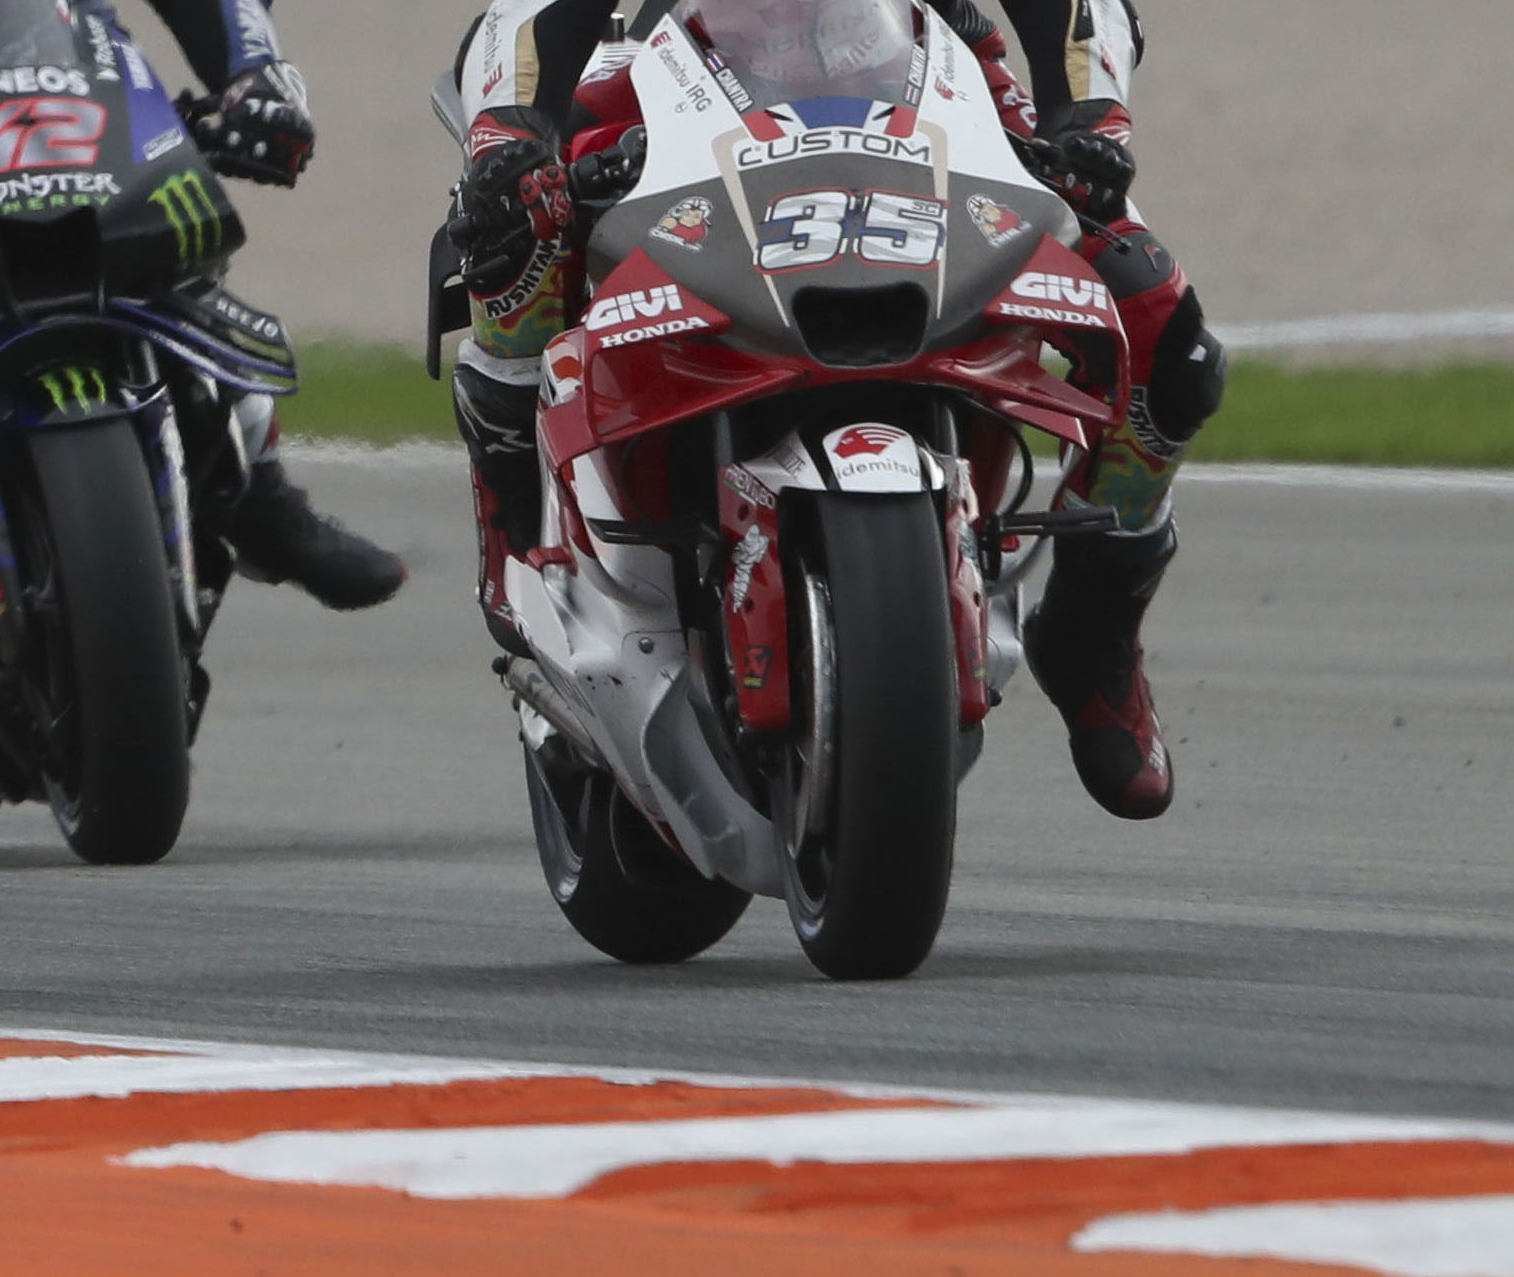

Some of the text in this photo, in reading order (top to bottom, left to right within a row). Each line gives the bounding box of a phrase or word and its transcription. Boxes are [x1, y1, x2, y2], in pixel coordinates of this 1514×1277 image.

[737, 128, 931, 168] CUSTOM
[757, 188, 944, 272] 35
[484, 240, 558, 318] RUSHITAN
[1009, 272, 1108, 310] GIVI
[585, 284, 683, 331] GIVI
[999, 301, 1107, 328] HONDA
[599, 316, 710, 349] HONDA
[836, 458, 920, 483] idemitsu
